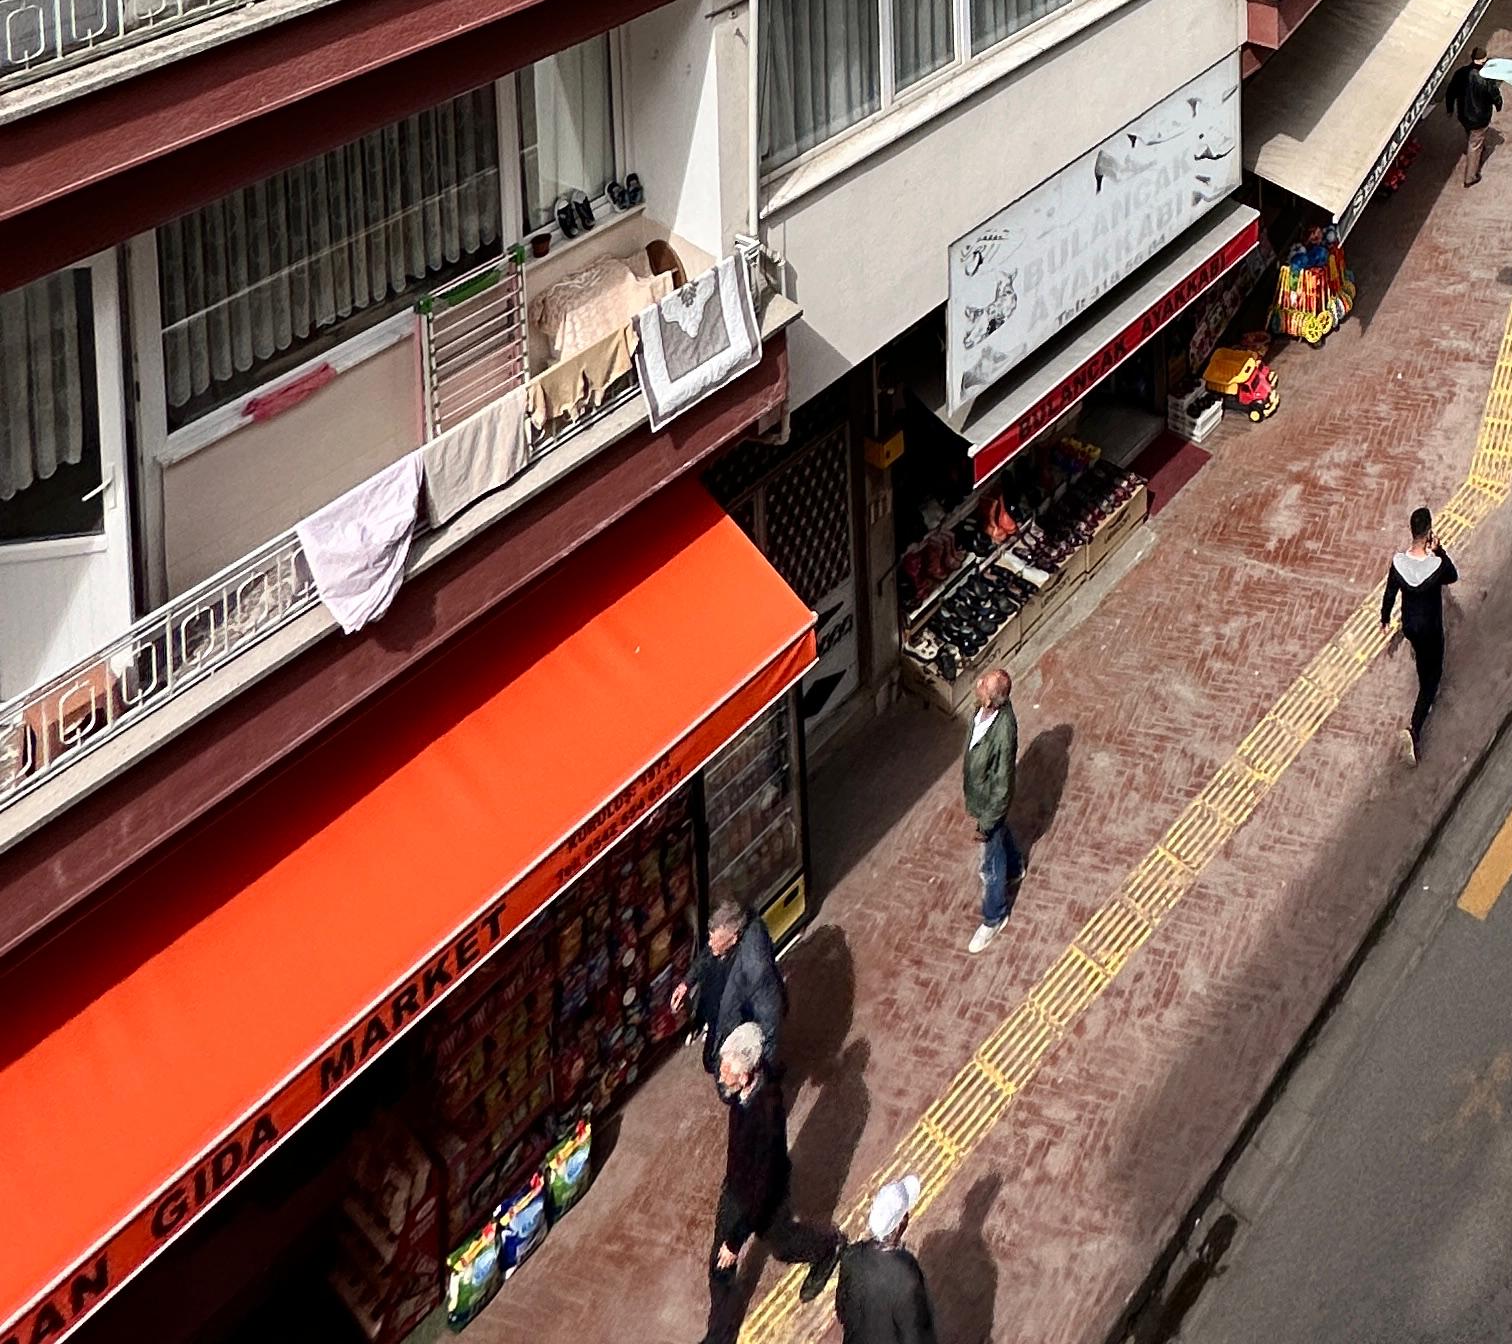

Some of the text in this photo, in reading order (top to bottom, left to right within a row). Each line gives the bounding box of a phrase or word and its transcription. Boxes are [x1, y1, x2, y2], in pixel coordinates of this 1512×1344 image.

[1023, 146, 1195, 292] BULANCAK
[1352, 140, 1398, 215] SEMA
[1029, 192, 1184, 324] AYAKKABI
[1018, 251, 1228, 439] BULANCAK AYAKKABI
[1, 905, 507, 1344] AN GIDA MARKET
